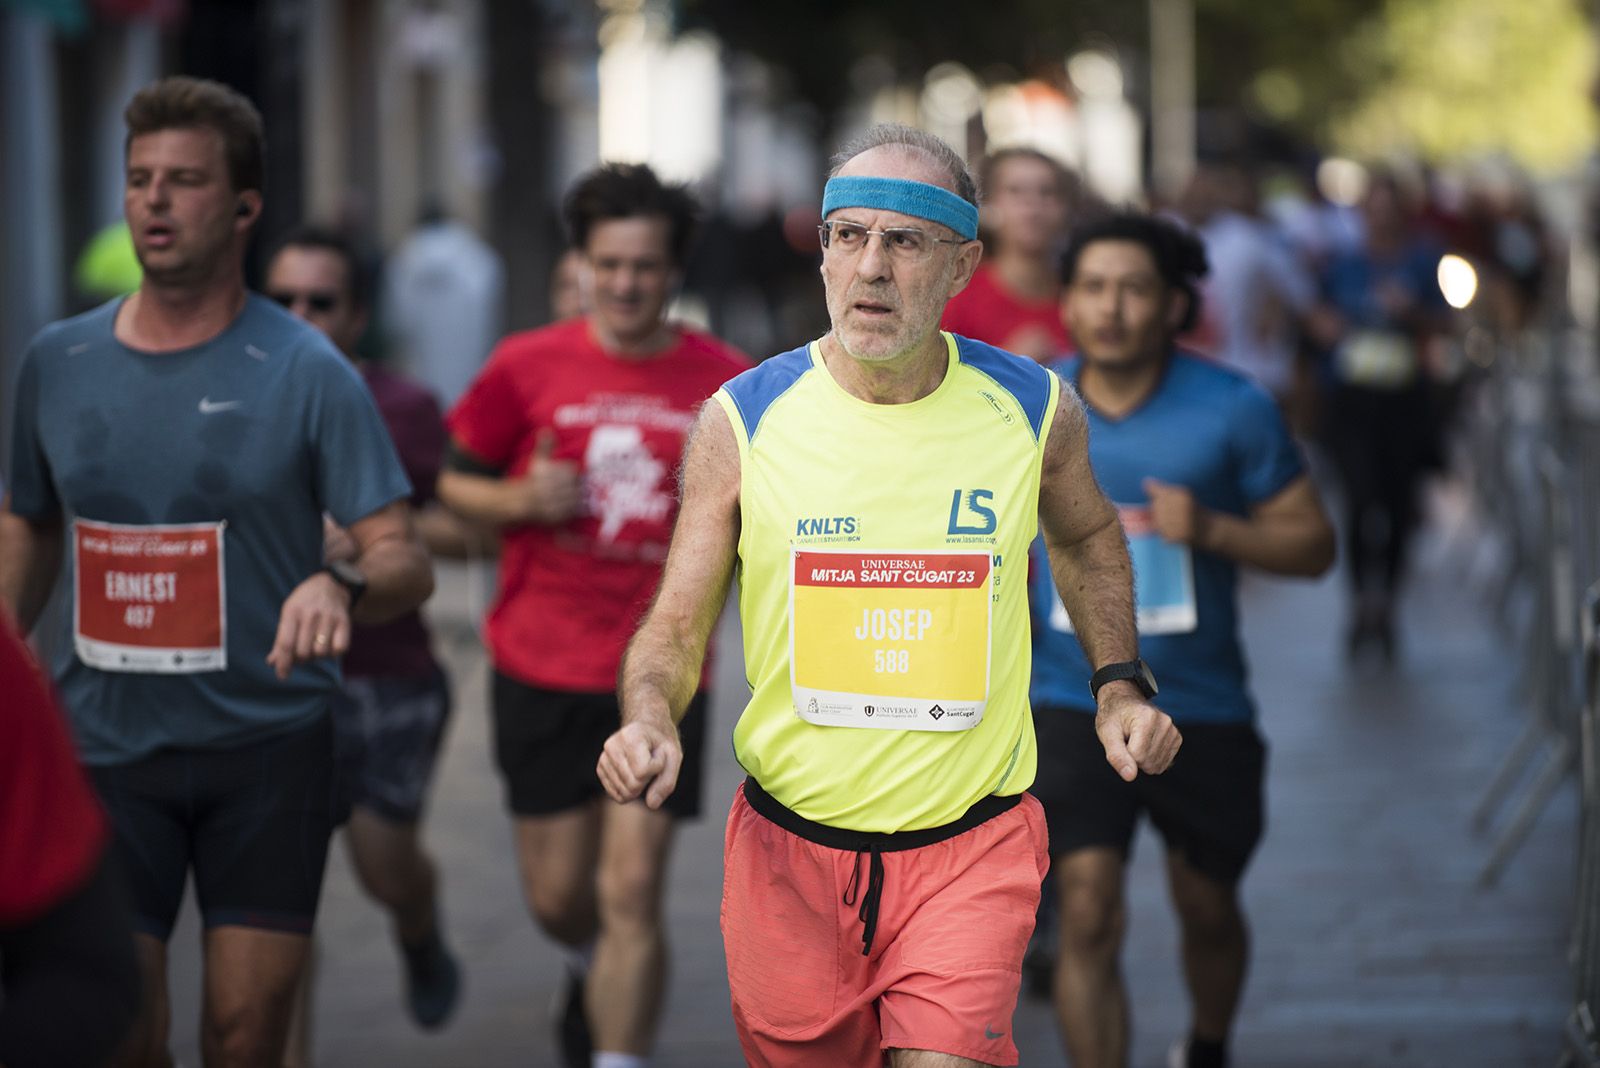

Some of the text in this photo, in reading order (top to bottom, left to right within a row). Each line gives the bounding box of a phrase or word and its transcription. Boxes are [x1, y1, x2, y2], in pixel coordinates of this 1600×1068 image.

[796, 516, 856, 536] KNLTS
[811, 568, 856, 583] MITJA
[860, 569, 901, 583] SANT
[902, 570, 956, 583] CUGAT
[956, 570, 976, 583] 23
[861, 559, 926, 570] UNIVERSAE
[104, 570, 177, 603] ERNEST
[855, 607, 932, 641] JOSEP
[874, 648, 910, 673] 588
